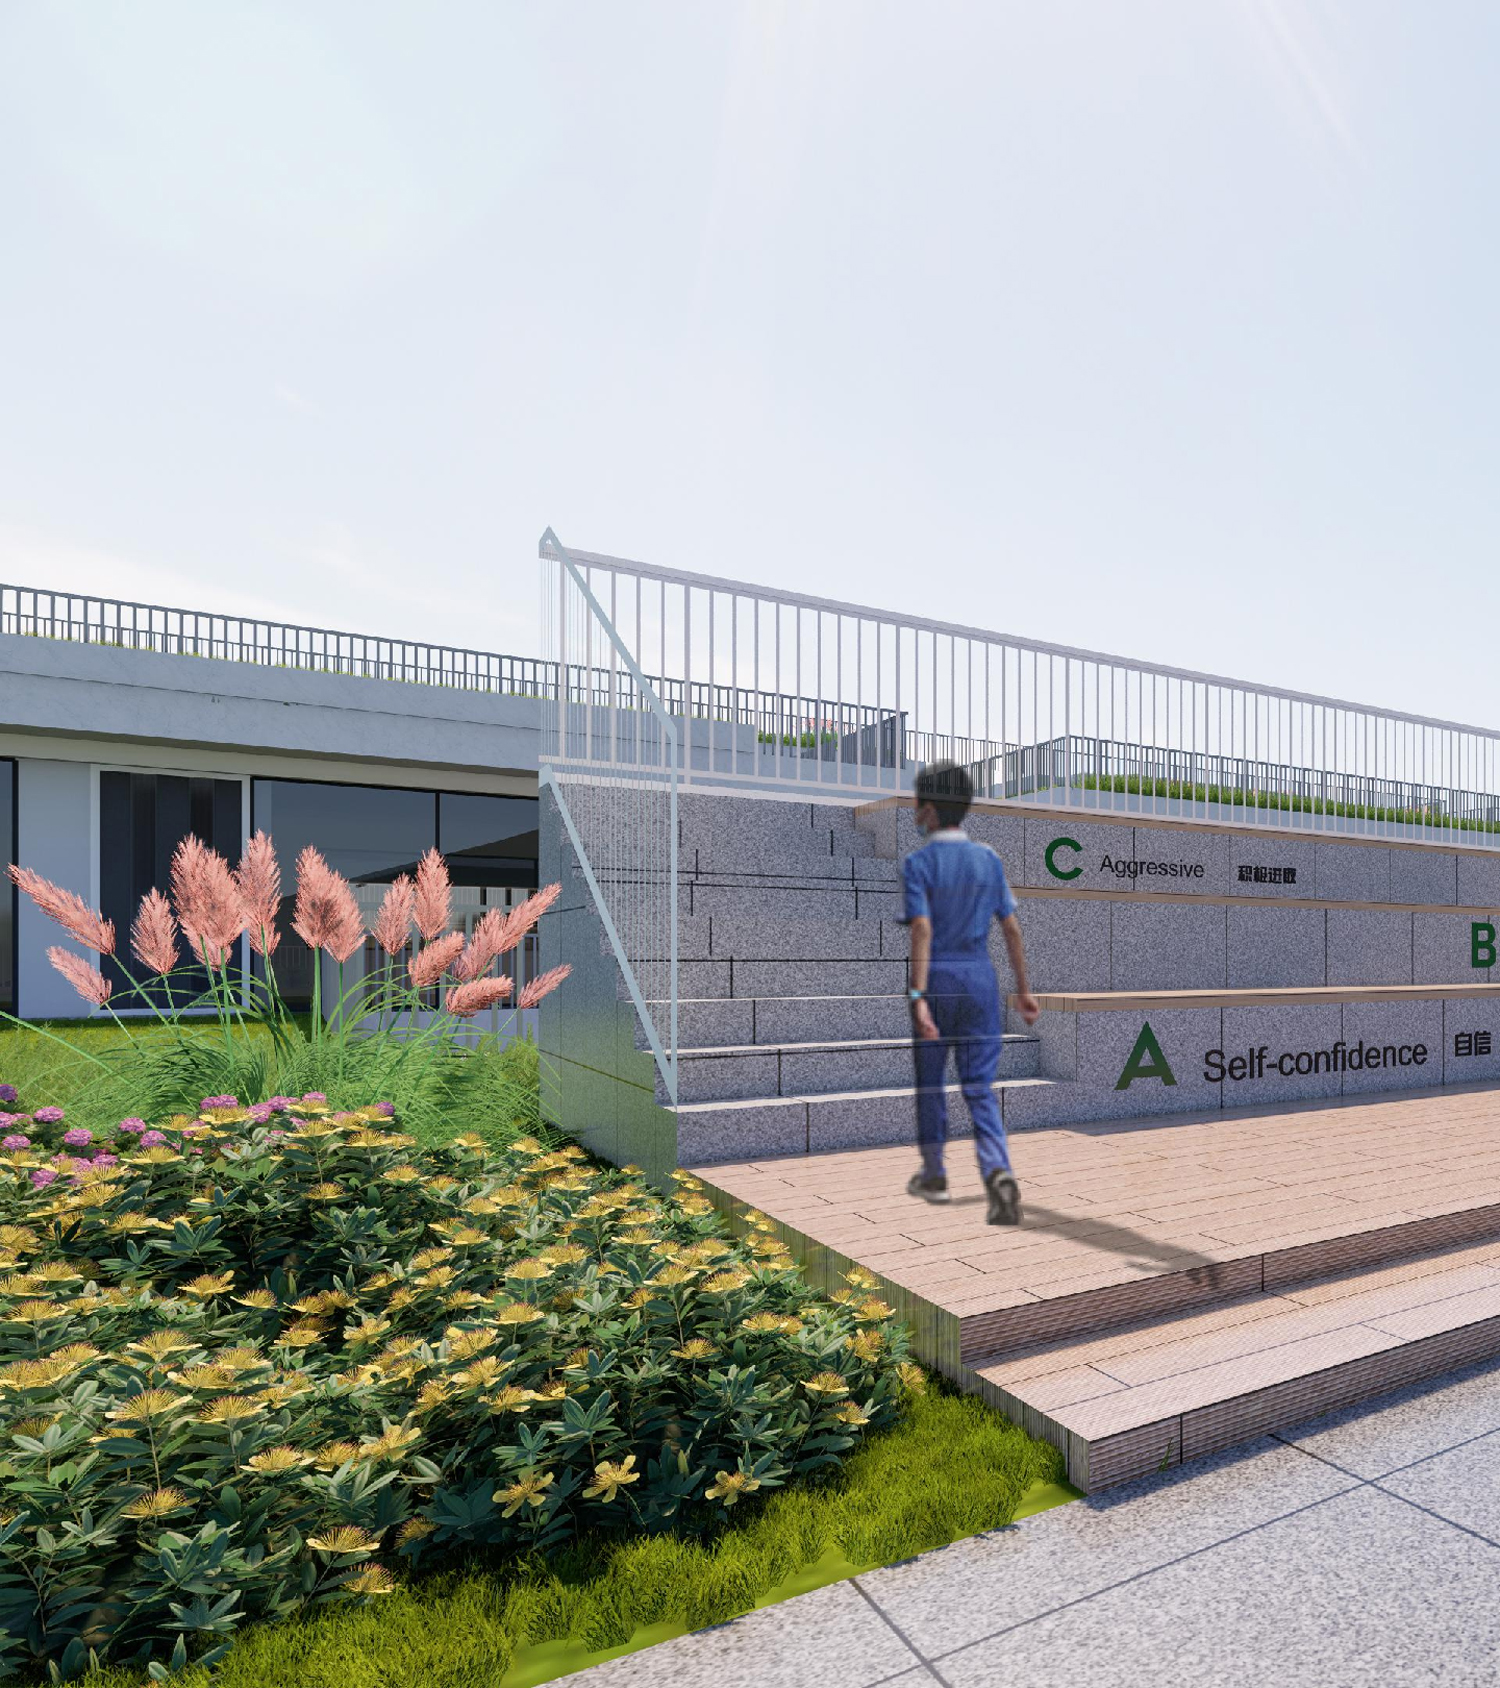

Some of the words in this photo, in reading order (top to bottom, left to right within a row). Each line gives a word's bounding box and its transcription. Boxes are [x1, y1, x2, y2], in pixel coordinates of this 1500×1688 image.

[1044, 837, 1084, 881] C
[1100, 854, 1205, 879] Aggressive
[1471, 921, 1497, 969] B
[1113, 1020, 1178, 1091] A
[1203, 1040, 1428, 1083] Self-confidence
[1454, 1030, 1492, 1058] 自信
